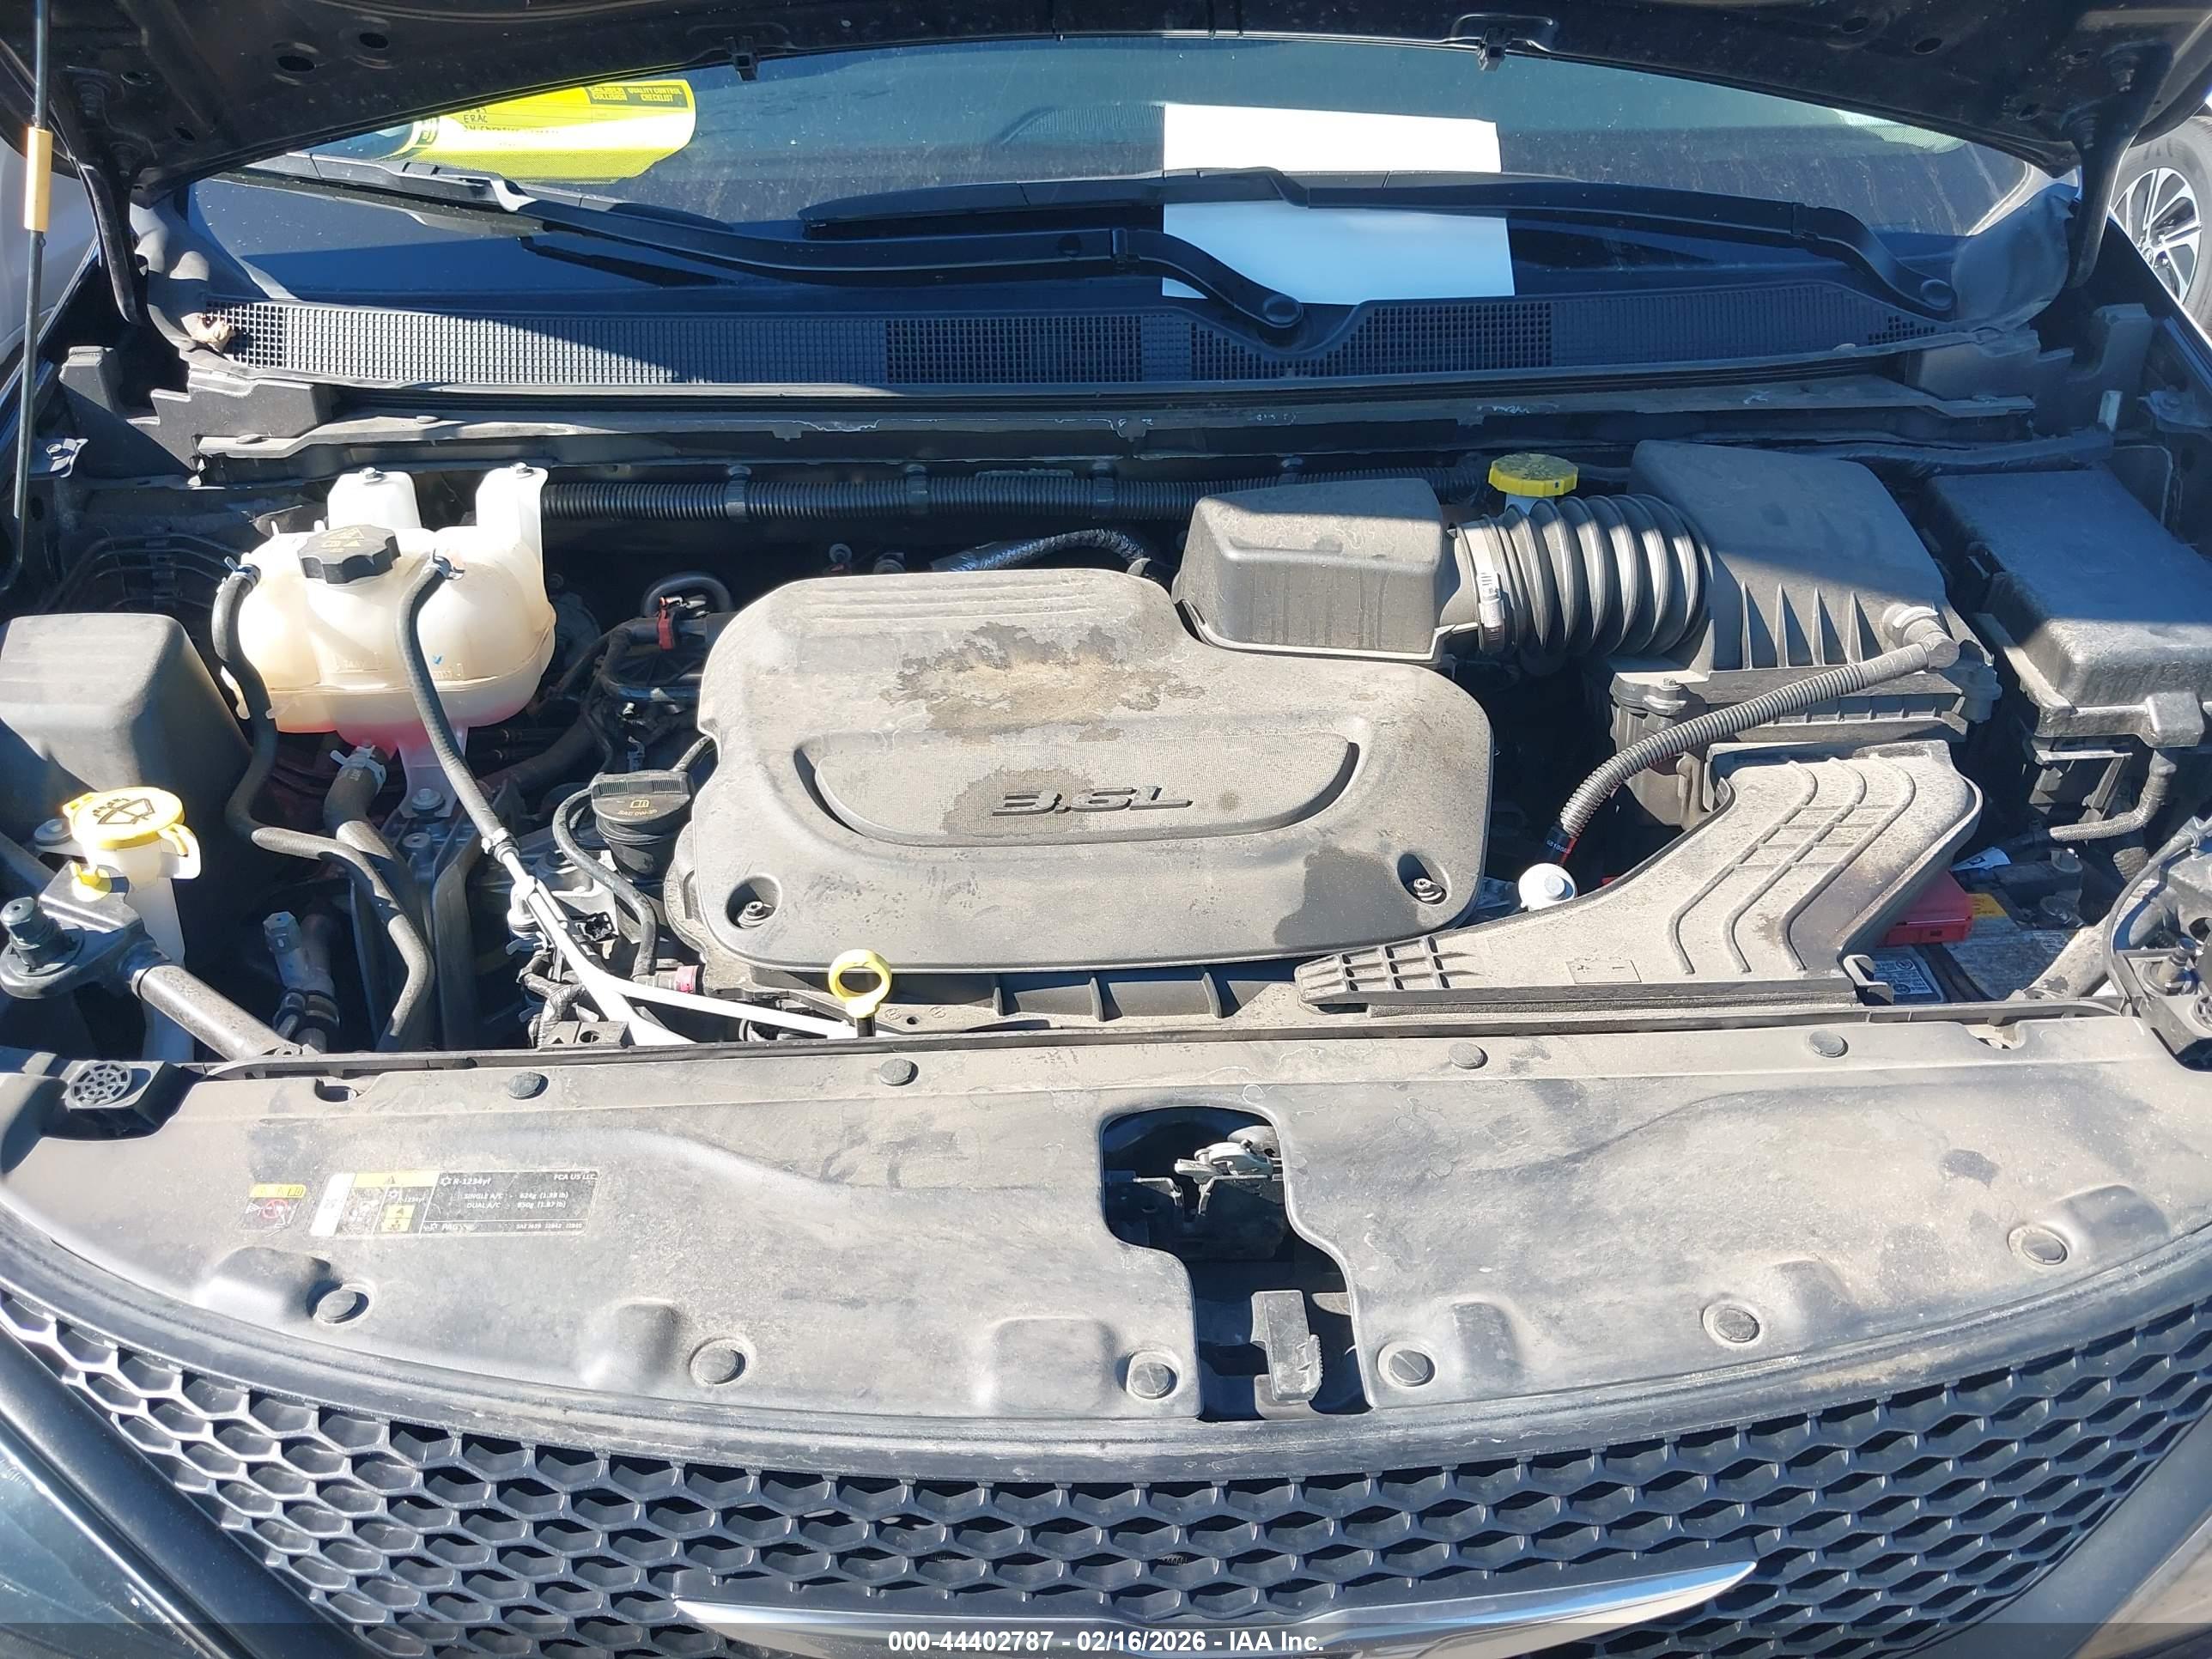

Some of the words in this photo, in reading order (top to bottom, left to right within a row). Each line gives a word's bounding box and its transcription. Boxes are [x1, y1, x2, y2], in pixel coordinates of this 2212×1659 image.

[640, 94, 674, 102] CHECKLIST
[991, 786, 1194, 817] 3.6L
[453, 1177, 492, 1187] R-1234yf
